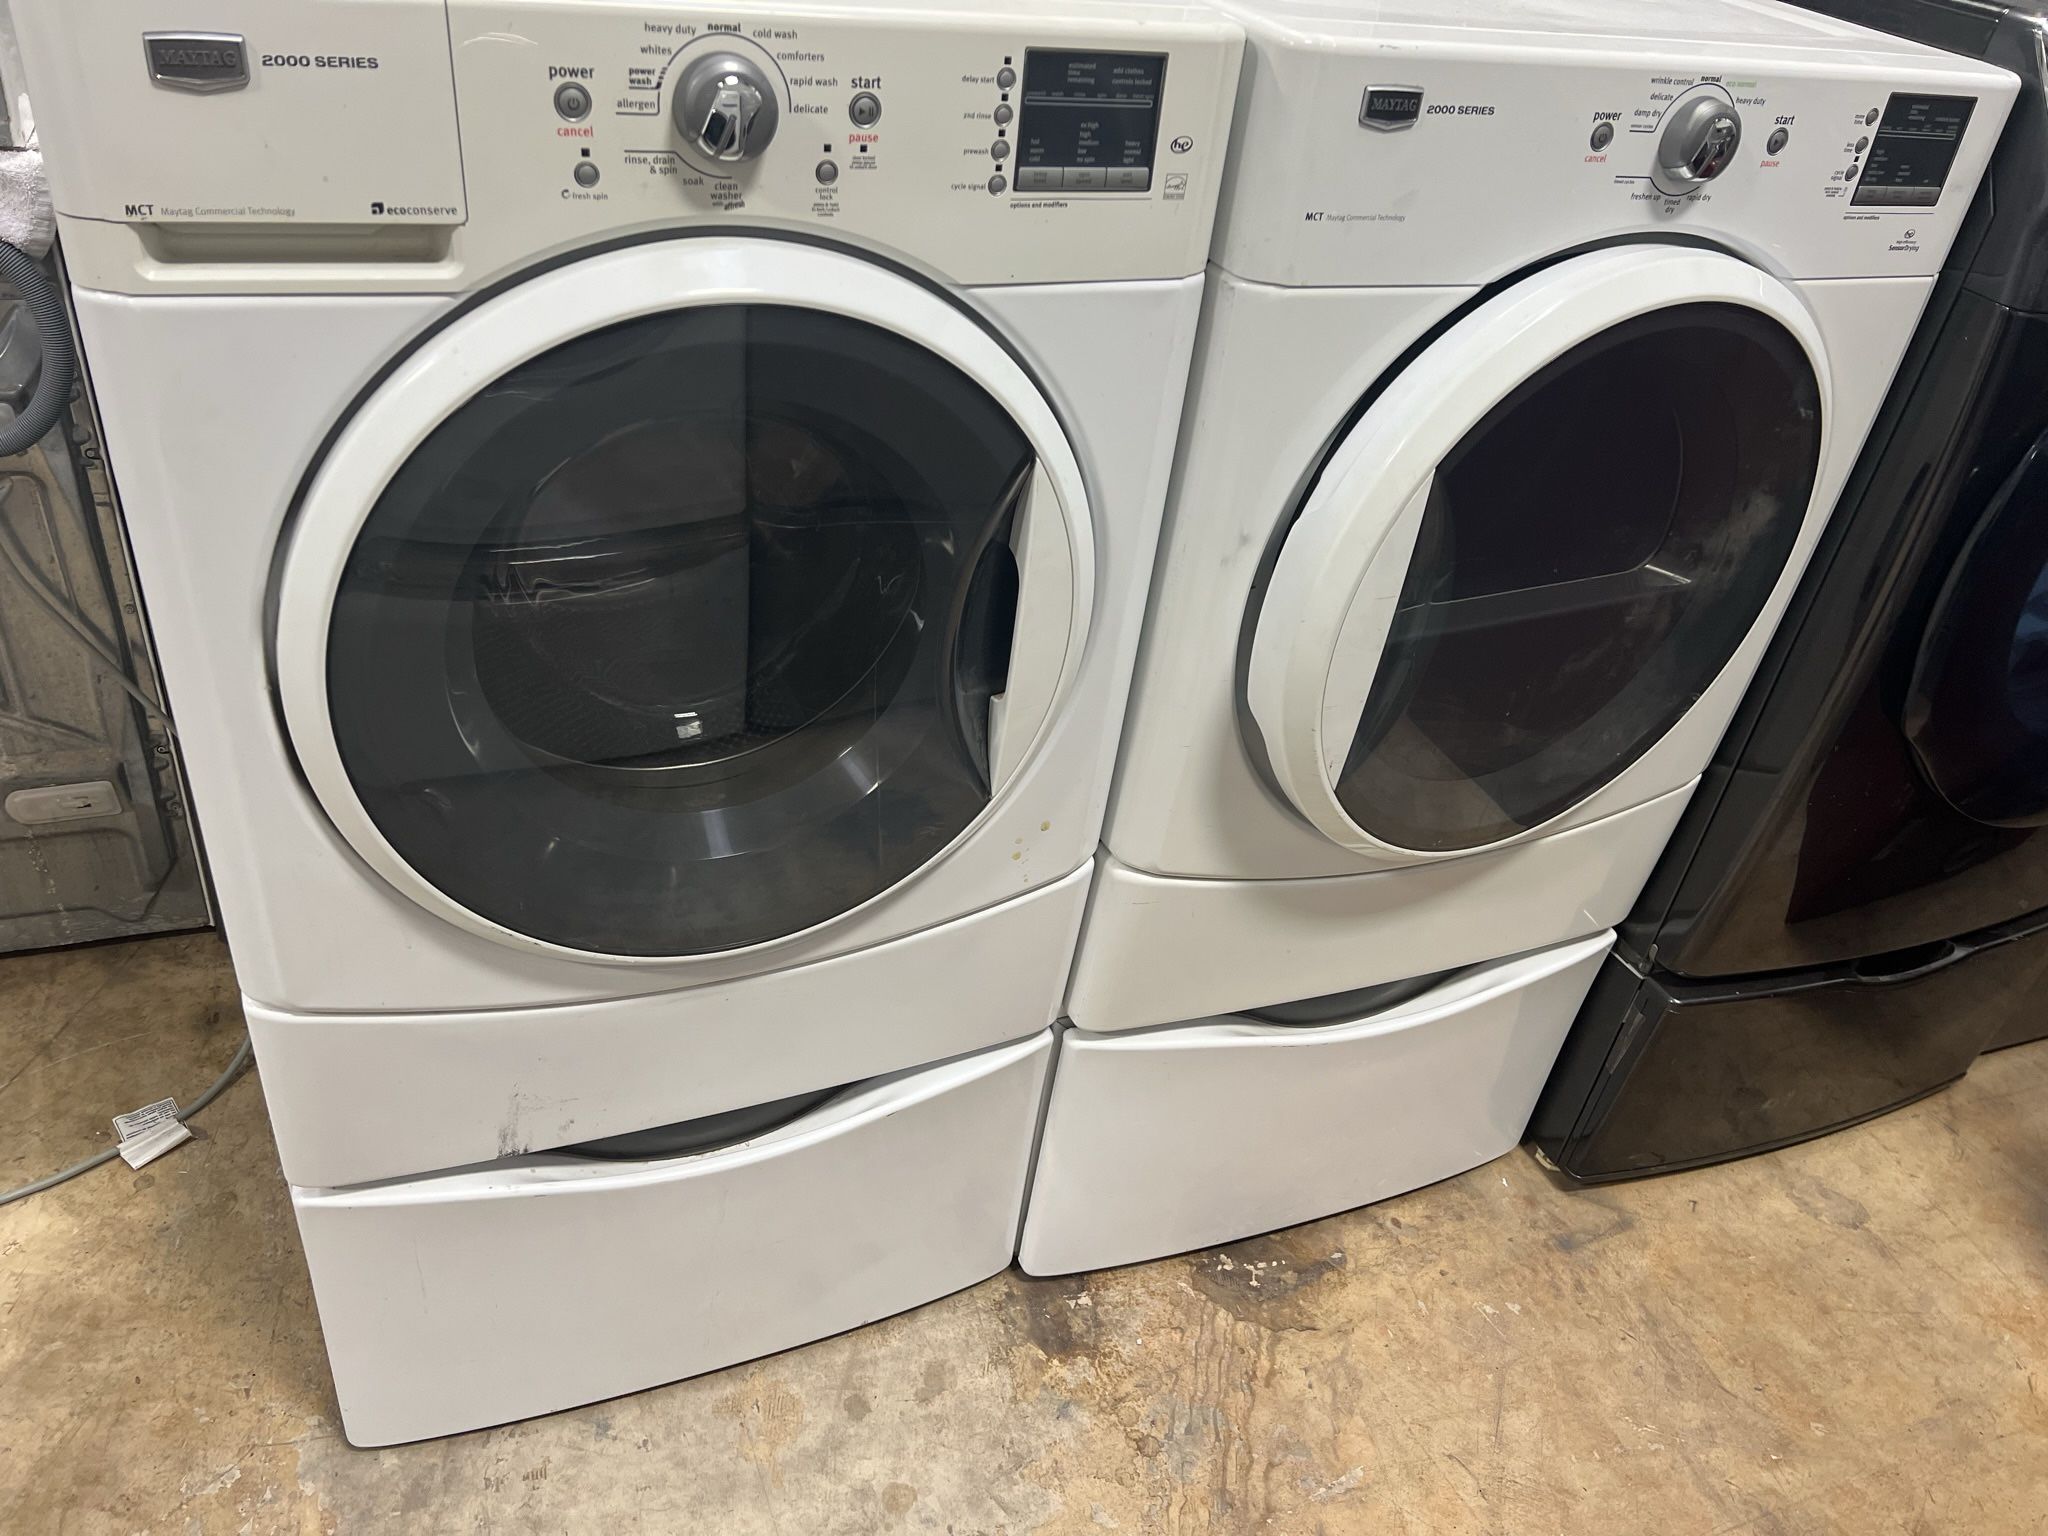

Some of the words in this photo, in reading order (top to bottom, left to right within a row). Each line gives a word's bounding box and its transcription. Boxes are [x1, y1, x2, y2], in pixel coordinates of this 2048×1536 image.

[645, 22, 673, 35] heavy
[675, 24, 697, 36] duty
[707, 23, 741, 32] normal
[753, 29, 772, 38] cold
[774, 30, 798, 39] wash
[640, 45, 673, 55] whites
[158, 49, 239, 68] MAYTAG
[776, 51, 825, 62] comforters
[261, 54, 311, 68] 2000
[315, 56, 379, 70] SERIES
[549, 66, 595, 81] power
[629, 67, 656, 77] power
[629, 77, 652, 85] wash
[790, 77, 813, 88] rapid
[815, 77, 838, 87] wash
[851, 76, 882, 89] start
[962, 75, 979, 84] delay
[980, 75, 995, 84] start
[1650, 77, 1673, 86] wrinkle
[1673, 78, 1695, 87] control
[1700, 75, 1722, 83] normal
[1650, 92, 1674, 102] delicate
[1736, 97, 1752, 106] heavy
[1752, 98, 1767, 106] duty
[617, 98, 656, 111] allergen
[793, 104, 829, 114] delicate
[1371, 97, 1418, 112] MAYTAG
[1426, 105, 1456, 115] 2000
[1457, 105, 1495, 116] SERIES
[1634, 109, 1651, 118] damp
[1652, 109, 1662, 119] dry
[1593, 110, 1622, 122] power
[1774, 115, 1795, 125] start
[557, 126, 594, 138] cancel
[849, 133, 879, 144] pause
[964, 148, 989, 157] prewash
[653, 155, 676, 165] drain
[1584, 154, 1607, 163] cancel
[1760, 159, 1780, 168] pause
[650, 166, 657, 174] &
[659, 166, 678, 175] spin
[683, 177, 705, 186] soak
[714, 182, 738, 191] clean
[951, 183, 967, 192] cycle
[968, 183, 986, 192] signal
[572, 192, 591, 200] fresh
[593, 192, 608, 201] spin
[710, 191, 743, 201] washer
[1630, 192, 1652, 201] freshen
[1653, 193, 1661, 202] up
[1686, 193, 1701, 202] rapid
[1702, 193, 1712, 202] dry
[1010, 202, 1030, 210] options
[1043, 201, 1068, 209] modifiers
[1664, 198, 1681, 206] timed
[125, 204, 155, 217] MCT
[161, 206, 194, 218] Maytag
[195, 206, 246, 217] Commercial
[247, 206, 296, 218] Technology
[386, 205, 458, 217] ecoconserve
[1665, 205, 1675, 214] dry
[1305, 212, 1324, 222] MCT
[1326, 214, 1346, 223] Maytag
[1347, 213, 1377, 222] Commercial
[1378, 213, 1406, 223] Technology
